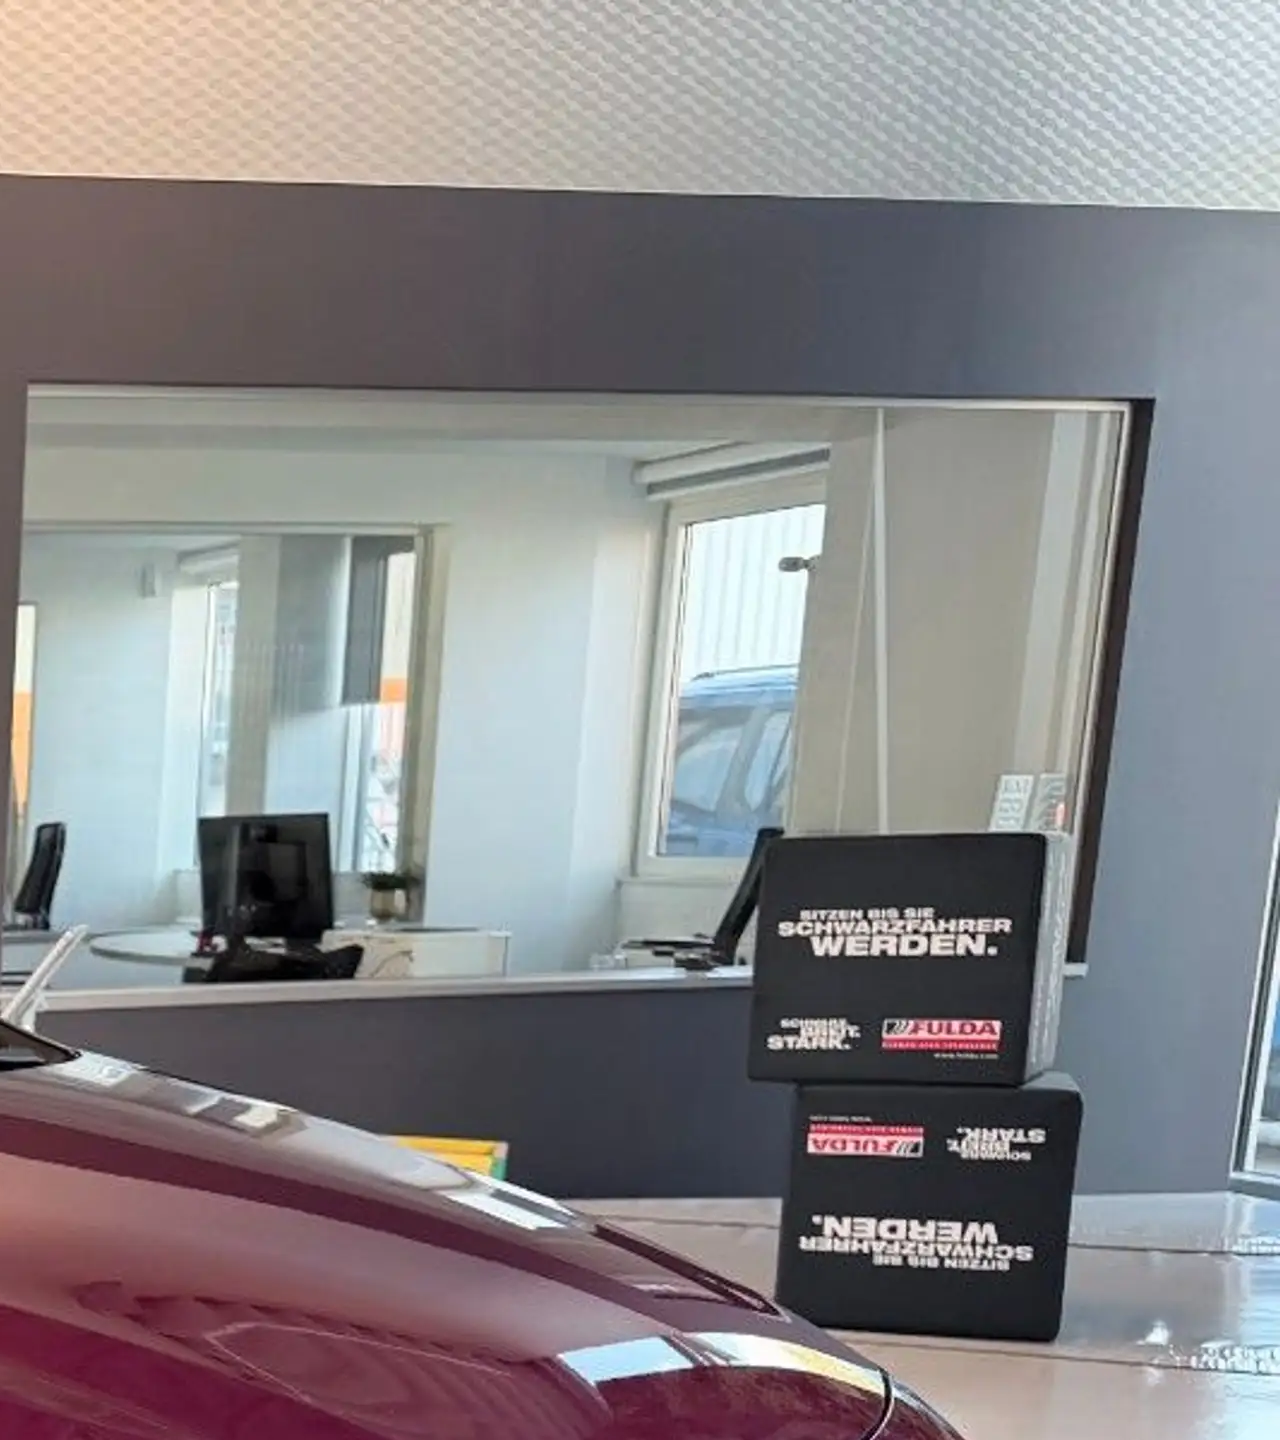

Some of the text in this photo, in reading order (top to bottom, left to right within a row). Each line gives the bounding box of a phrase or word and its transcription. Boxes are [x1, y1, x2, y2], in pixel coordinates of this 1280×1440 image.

[799, 908, 864, 921] SITZEN
[778, 917, 1013, 937] SCHWARZFAHRER
[810, 934, 999, 957] WERDEN.
[908, 1019, 999, 1036] FULDA
[811, 1138, 899, 1152] FULDA
[812, 1215, 999, 1244] WERDEN.
[799, 1236, 1034, 1262] SCHWARZFAHRER
